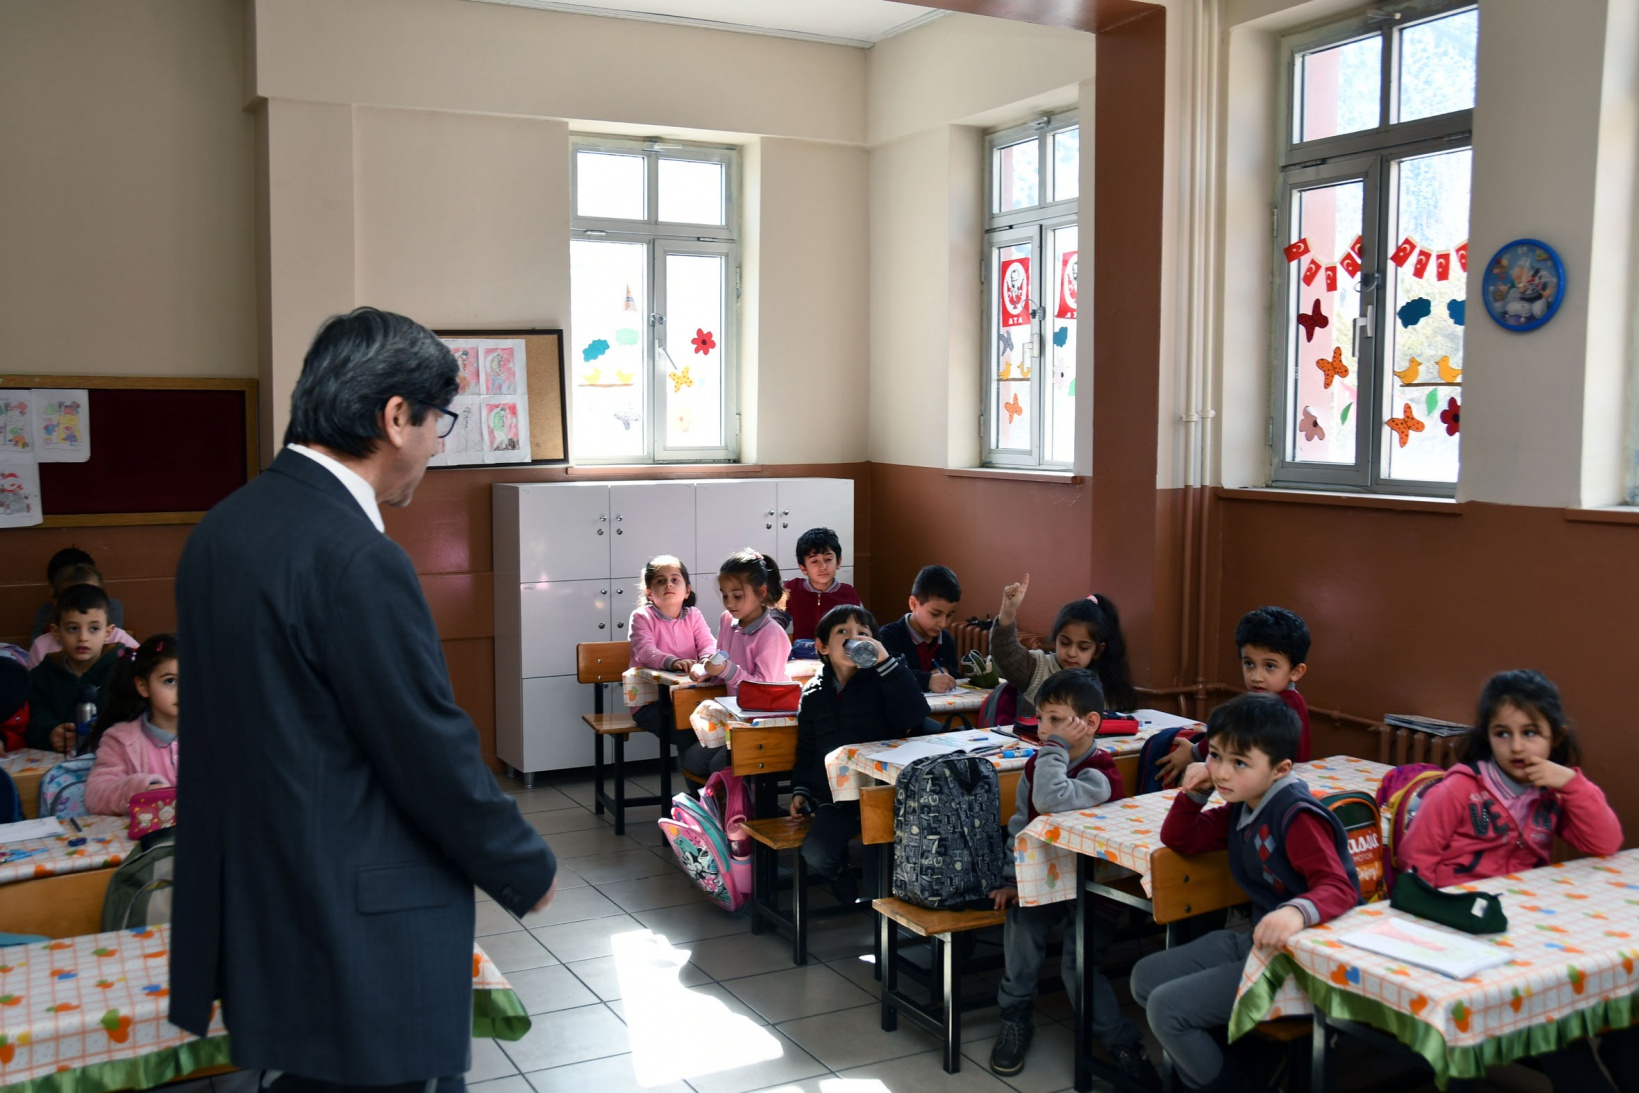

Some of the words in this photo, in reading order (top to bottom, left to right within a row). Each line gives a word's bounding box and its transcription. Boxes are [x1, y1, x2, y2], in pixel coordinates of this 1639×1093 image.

[1008, 317, 1023, 325] ATA
[1347, 830, 1379, 854] assic
[1353, 852, 1373, 862] MOTOR
